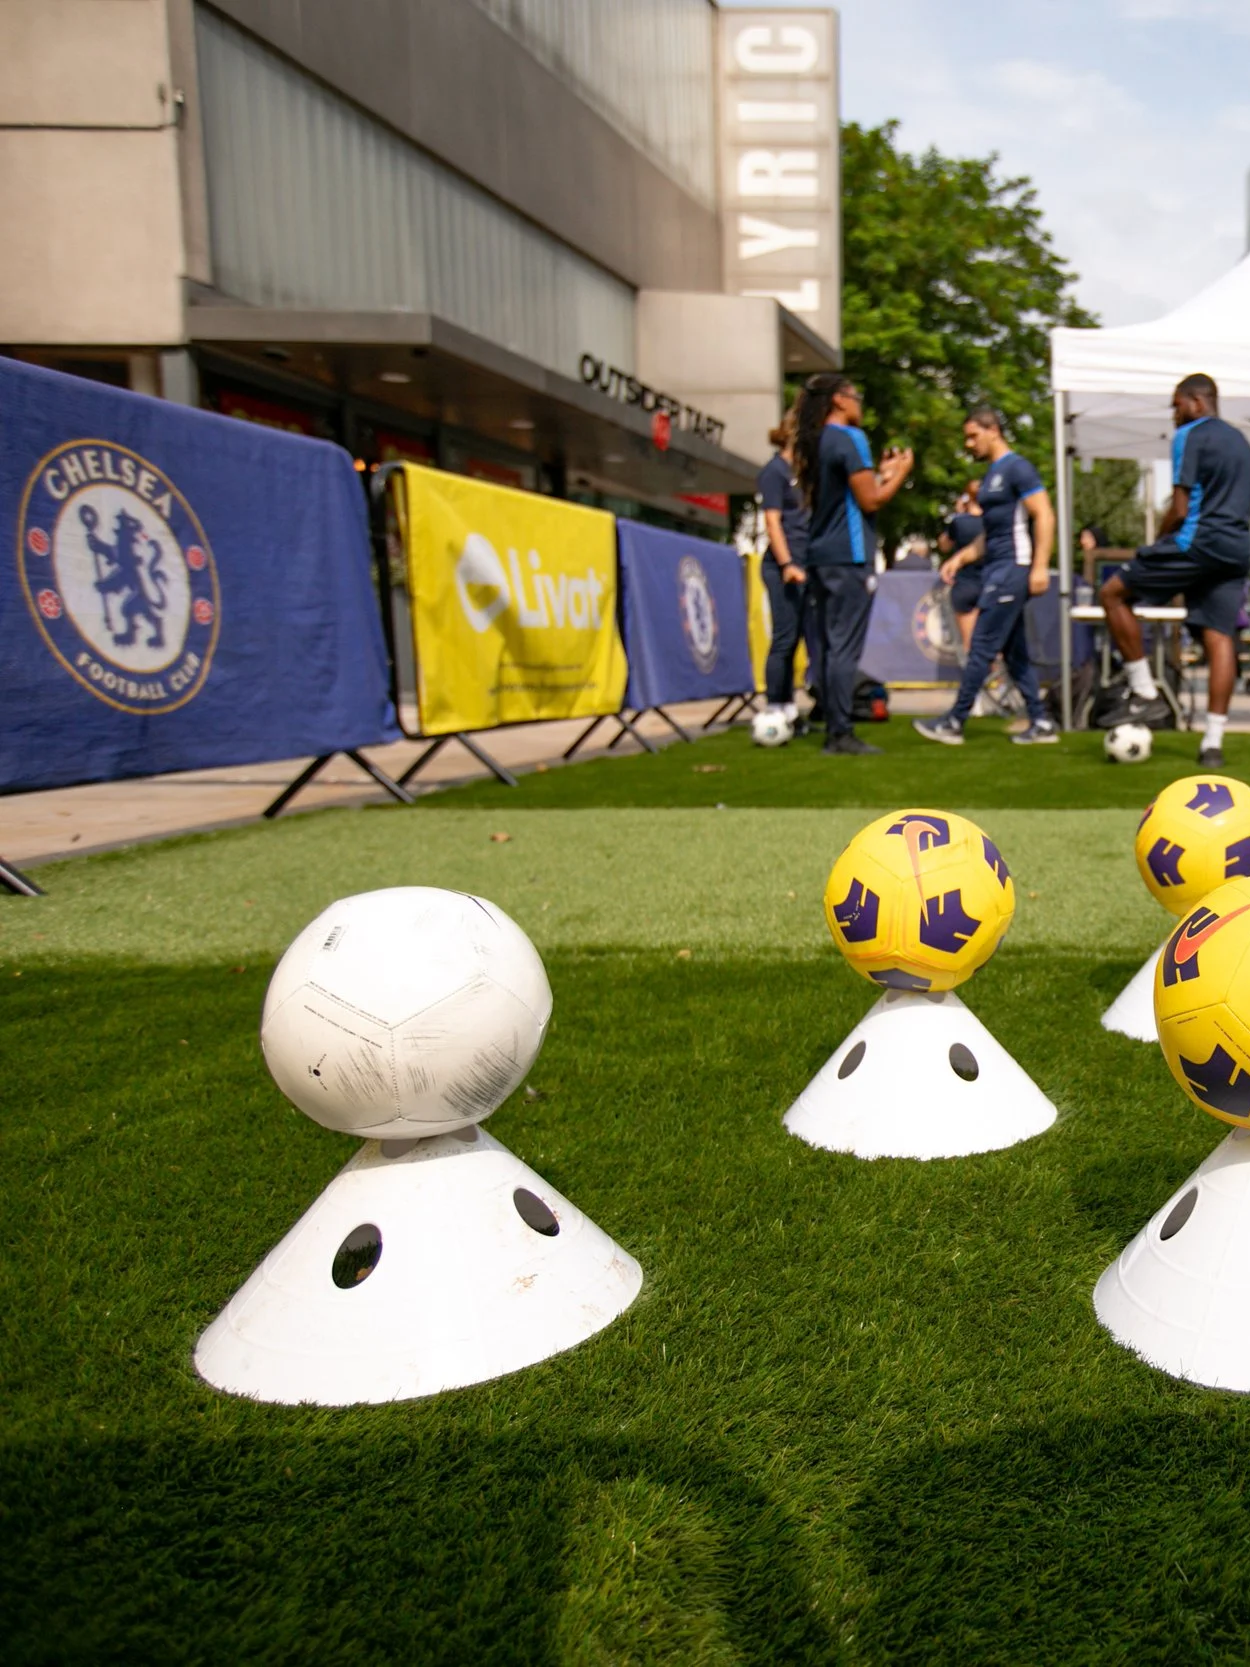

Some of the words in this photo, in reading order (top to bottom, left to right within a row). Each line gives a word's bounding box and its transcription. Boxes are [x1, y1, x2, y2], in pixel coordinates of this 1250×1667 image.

[734, 25, 820, 312] LYRIC
[45, 449, 173, 518] CHELSEA
[507, 547, 604, 630] Livat
[76, 651, 168, 700] FOOTBALL
